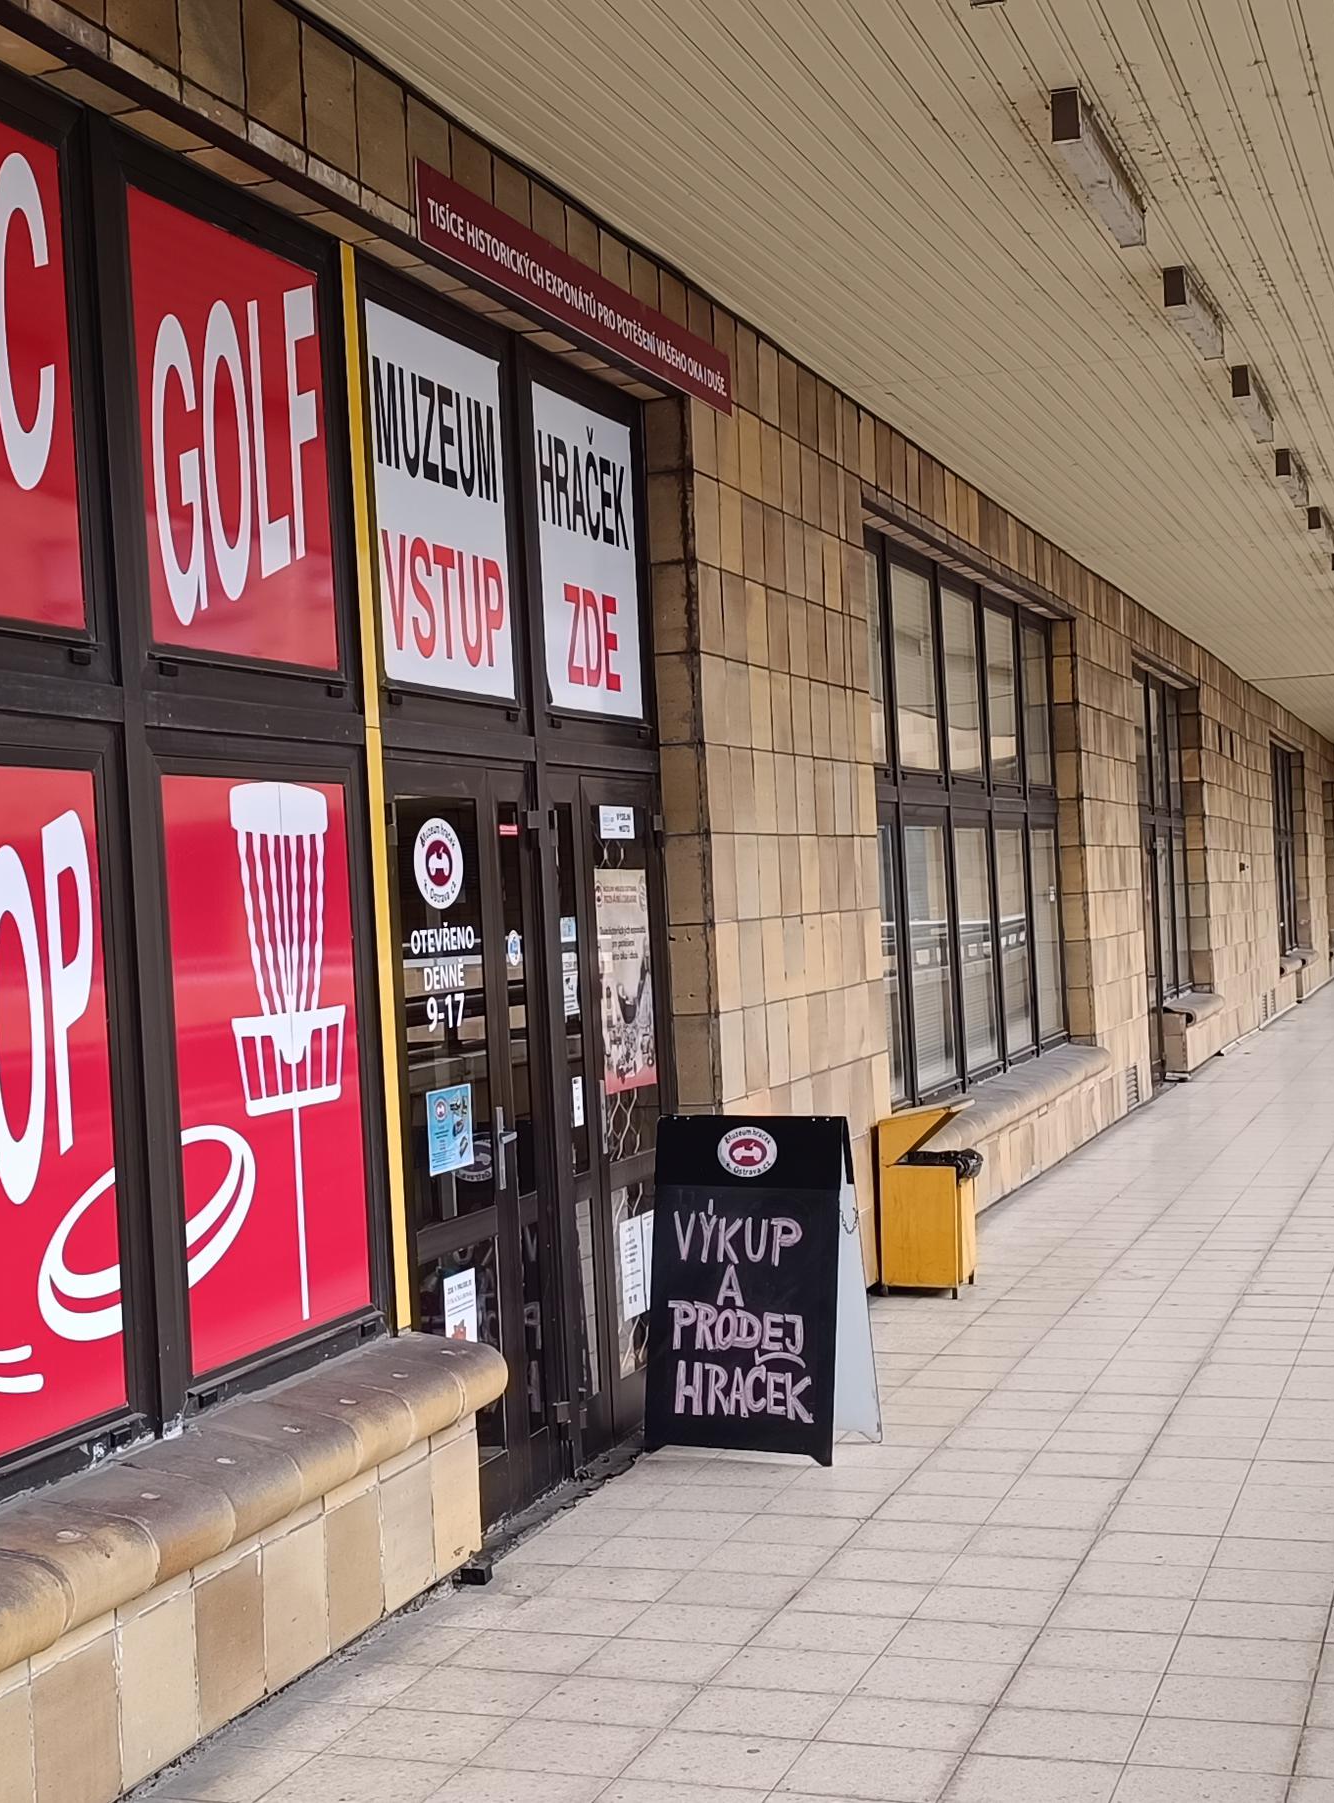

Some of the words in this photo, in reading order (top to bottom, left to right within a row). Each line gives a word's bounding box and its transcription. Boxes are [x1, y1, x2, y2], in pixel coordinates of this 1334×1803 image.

[427, 197, 465, 242] TISÍCE
[466, 220, 544, 289] HISTORICKÝCH
[545, 270, 596, 319] EXPONÁTŮ
[597, 302, 616, 330] PRO
[617, 313, 656, 356] POTĚŠENÍ
[656, 338, 687, 373] VAŠEHO
[687, 357, 703, 383] OKA
[152, 283, 318, 626] GOLF
[372, 355, 498, 504] MUZEUM
[537, 426, 630, 551] HRAČEK
[380, 528, 505, 668] VSTUP
[563, 582, 622, 692] ZDE
[410, 921, 475, 955] OTEVŘENO
[423, 958, 465, 992] DENNĚ
[426, 992, 465, 1033] 9-17
[674, 1198, 803, 1267] VÝKUP
[717, 1263, 745, 1307] A
[668, 1300, 804, 1355] PRODEJ
[674, 1349, 815, 1424] HRAČEK
